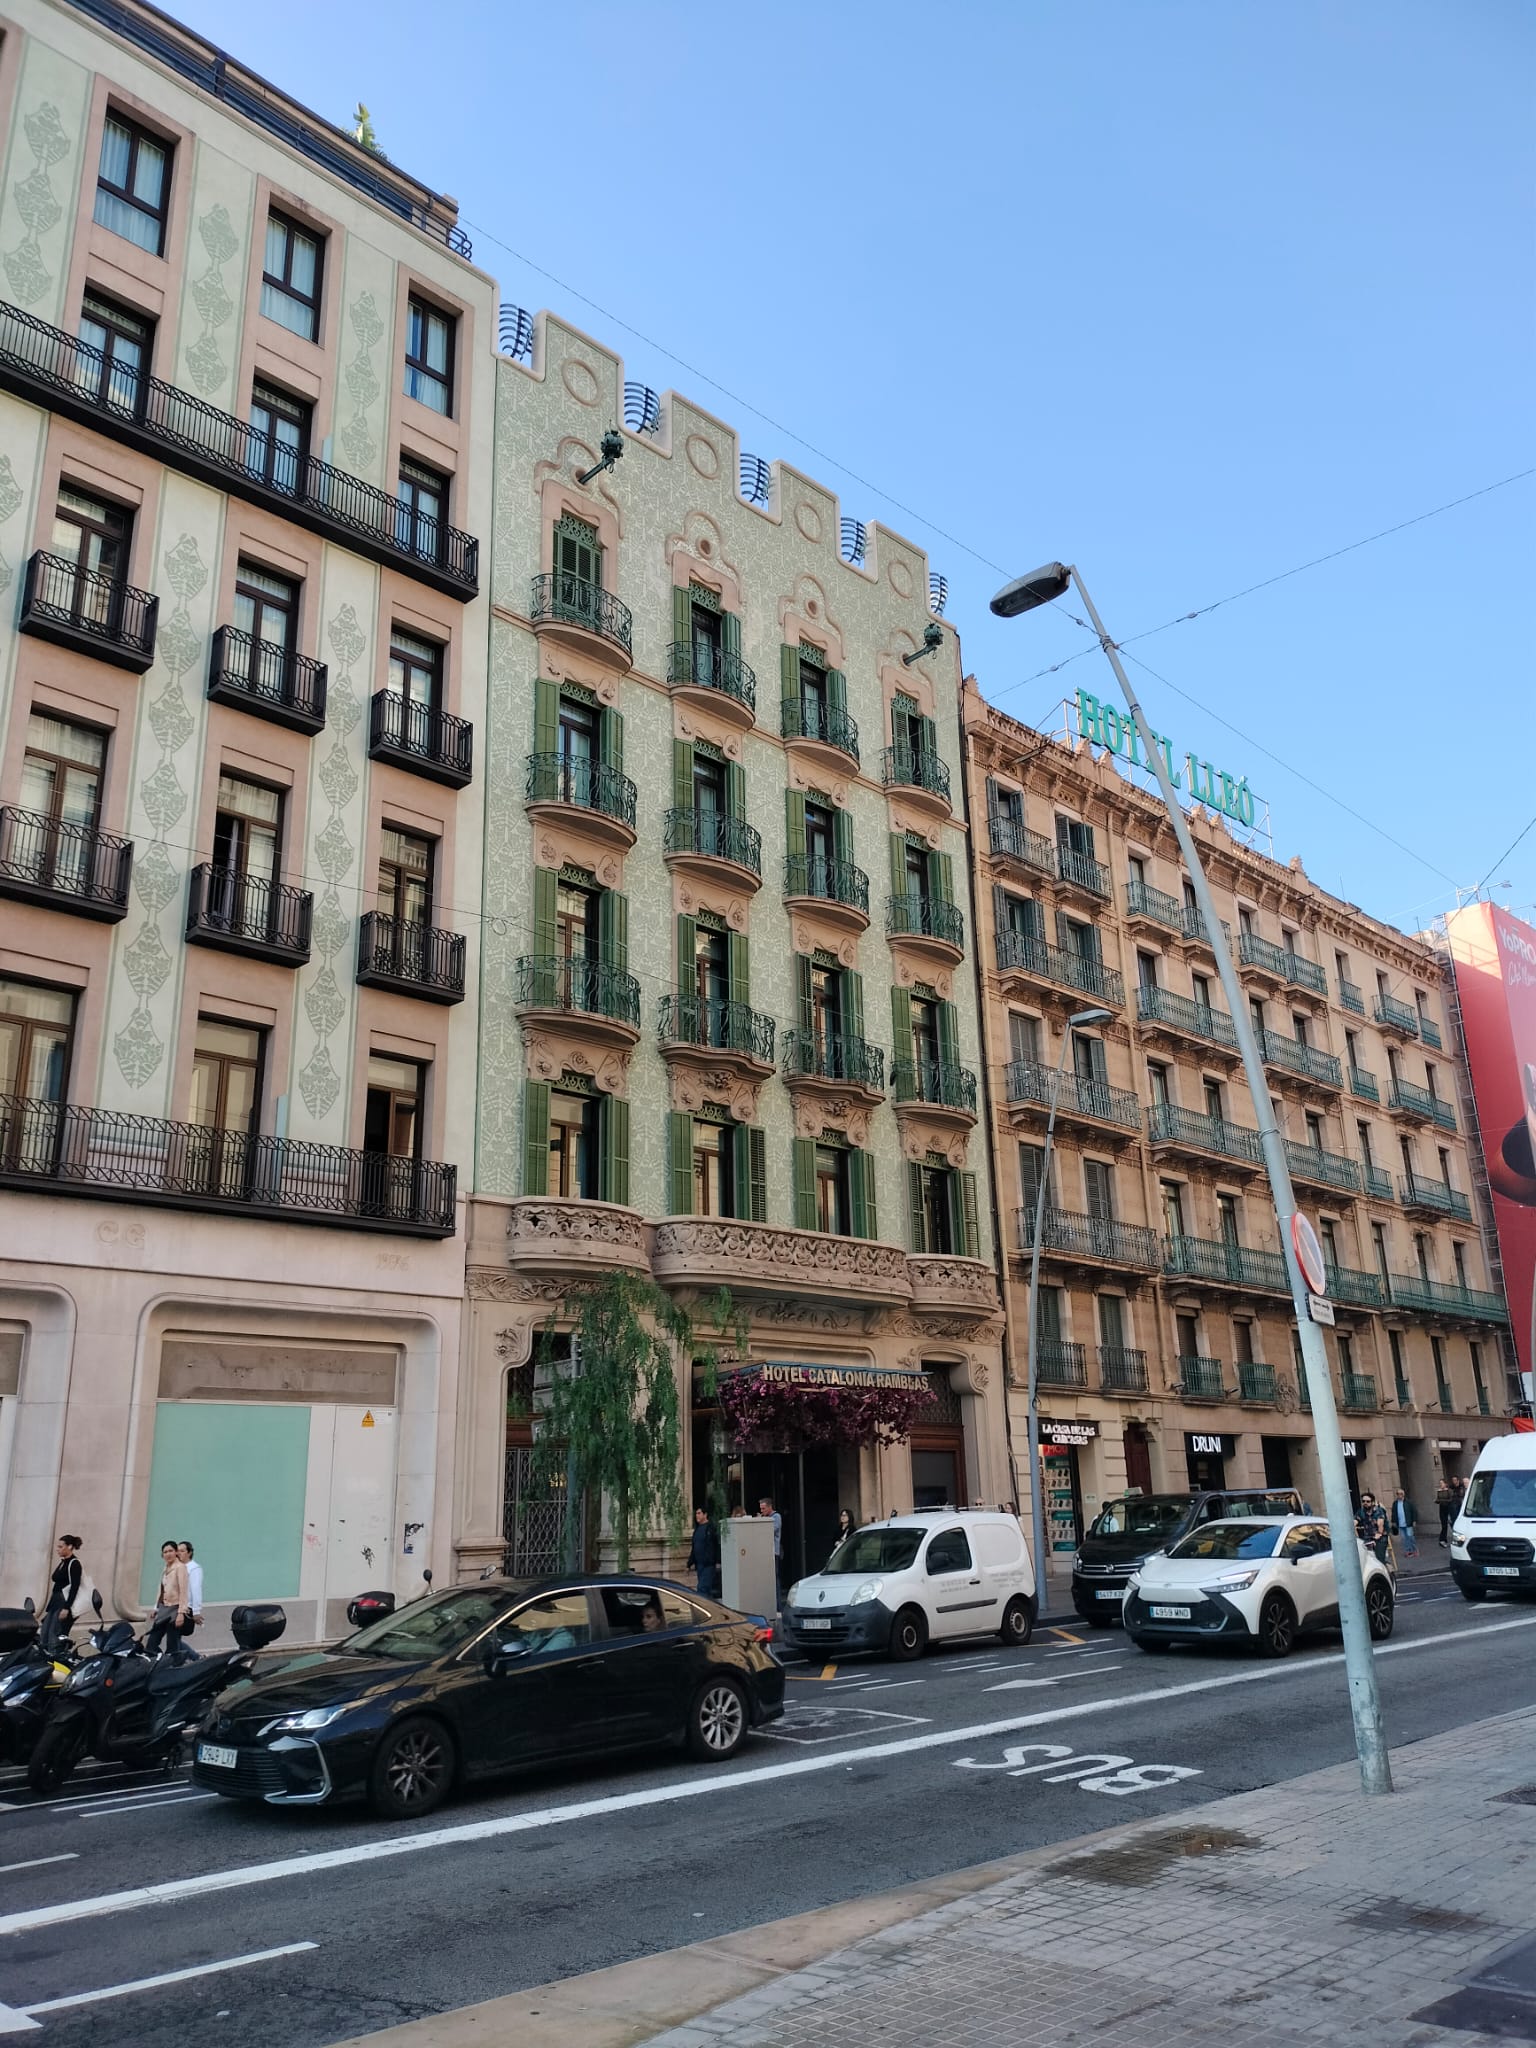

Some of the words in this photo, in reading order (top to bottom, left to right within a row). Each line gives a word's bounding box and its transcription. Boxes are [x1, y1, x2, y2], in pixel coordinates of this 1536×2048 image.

[1186, 752, 1254, 827] LLEÓ
[764, 1364, 806, 1383] HOTEL
[808, 1368, 875, 1387] CATALONIA
[876, 1374, 929, 1391] RAMBLAS
[1042, 1424, 1052, 1434] LA
[1052, 1424, 1071, 1435] CASA
[1081, 1426, 1096, 1436] LAS
[1052, 1434, 1089, 1445] CARCASAS
[1192, 1435, 1222, 1453] DRUNI
[1155, 1608, 1173, 1617] 4959
[950, 1744, 1205, 1795] BUS
